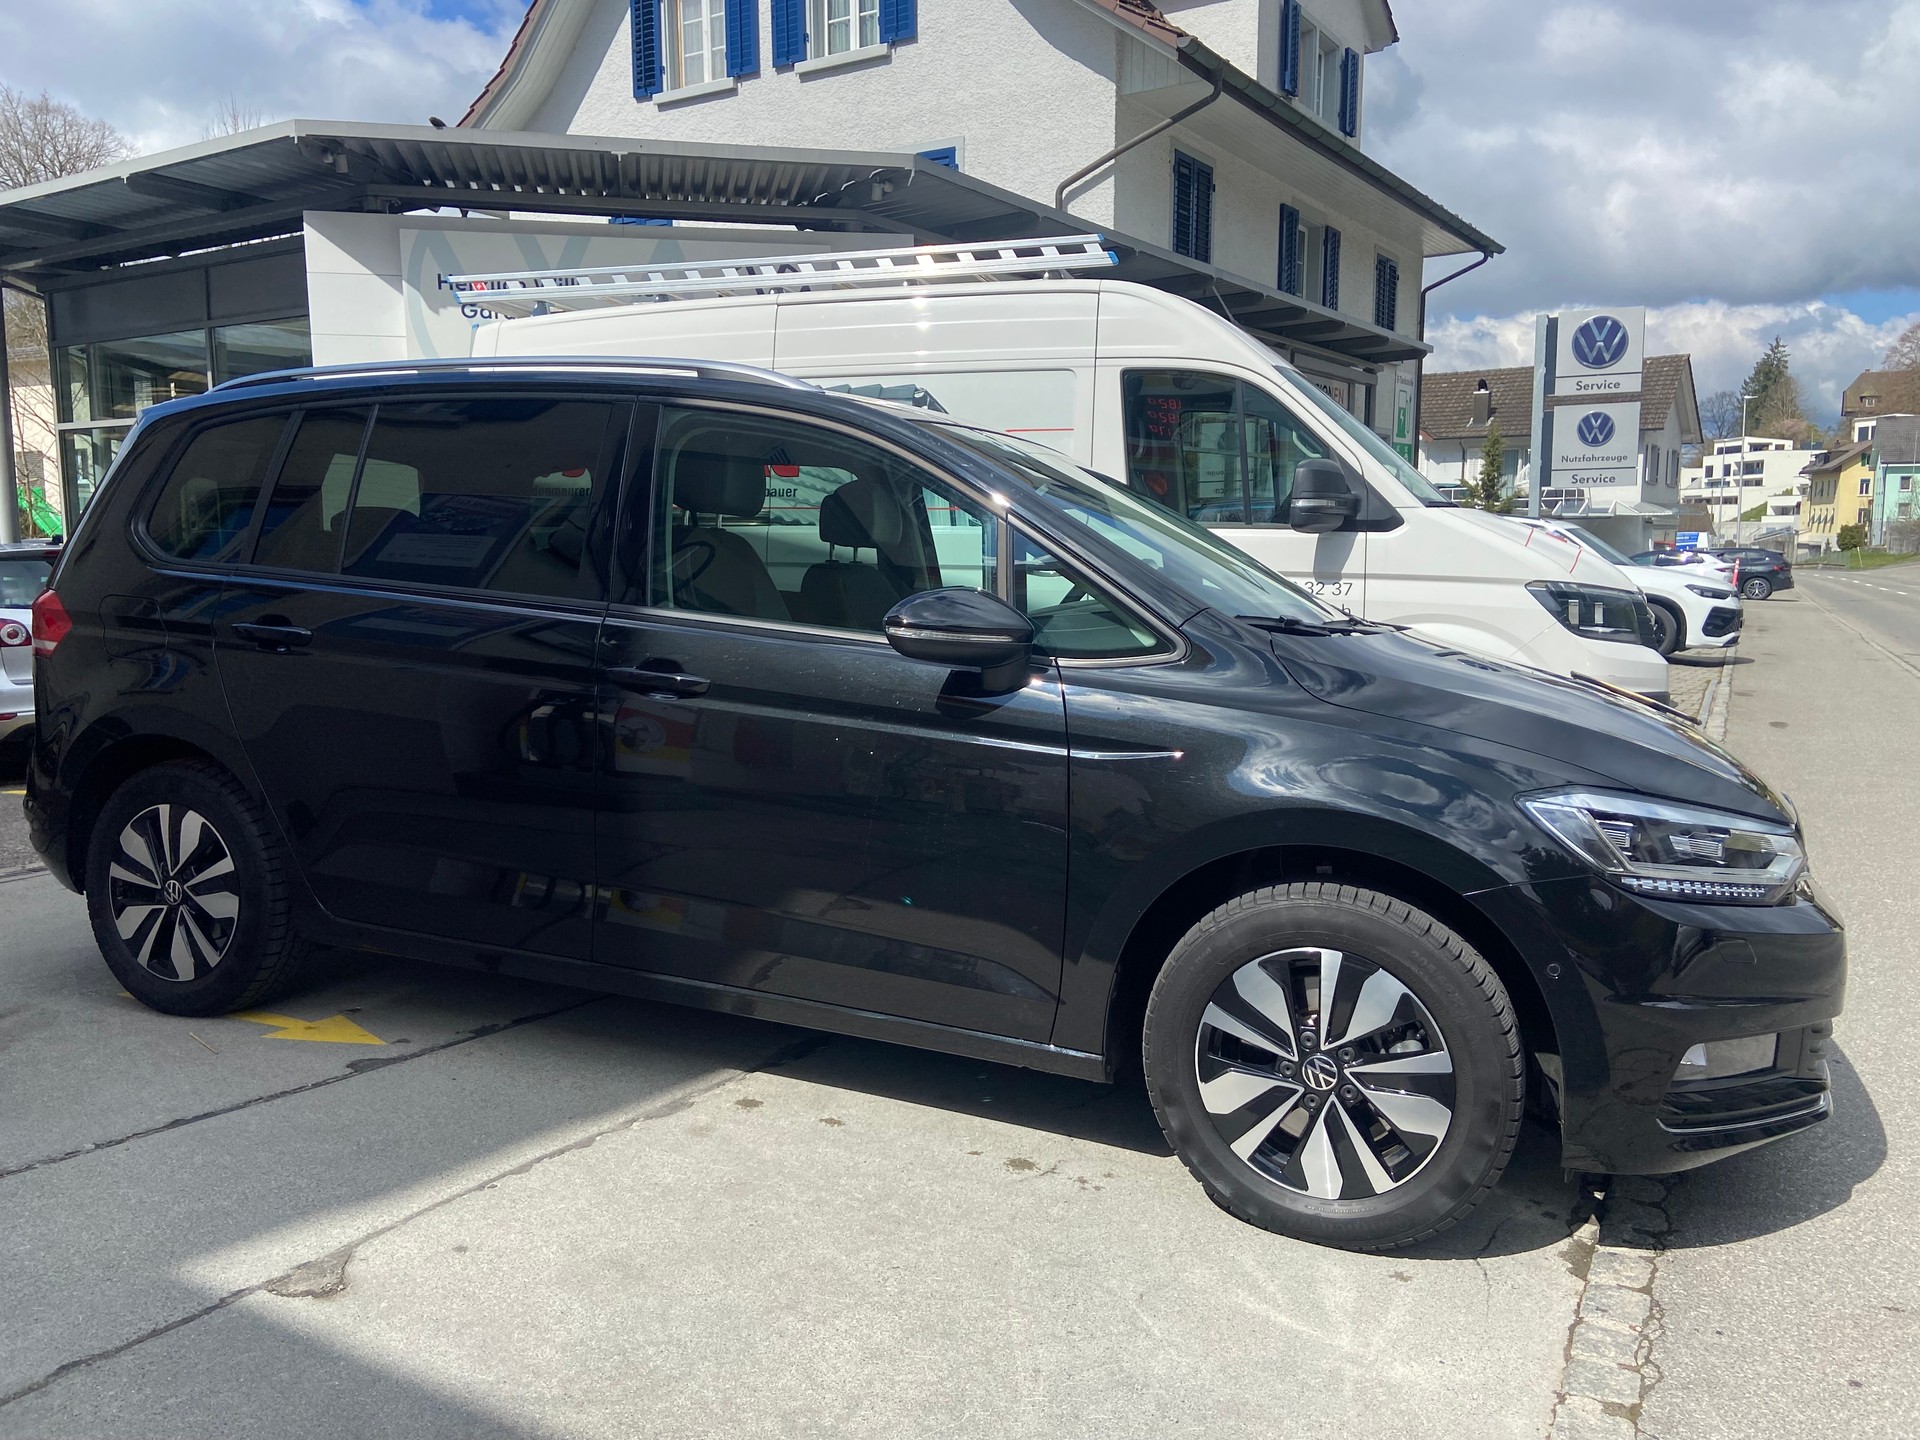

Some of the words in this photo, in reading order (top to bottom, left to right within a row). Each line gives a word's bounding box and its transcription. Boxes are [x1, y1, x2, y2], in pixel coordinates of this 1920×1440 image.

[1576, 380, 1620, 391] Service
[1561, 453, 1628, 463] Nutzfahrzeuge
[1571, 474, 1616, 484] Service
[1305, 581, 1325, 595] 32
[1332, 581, 1353, 596] 37
